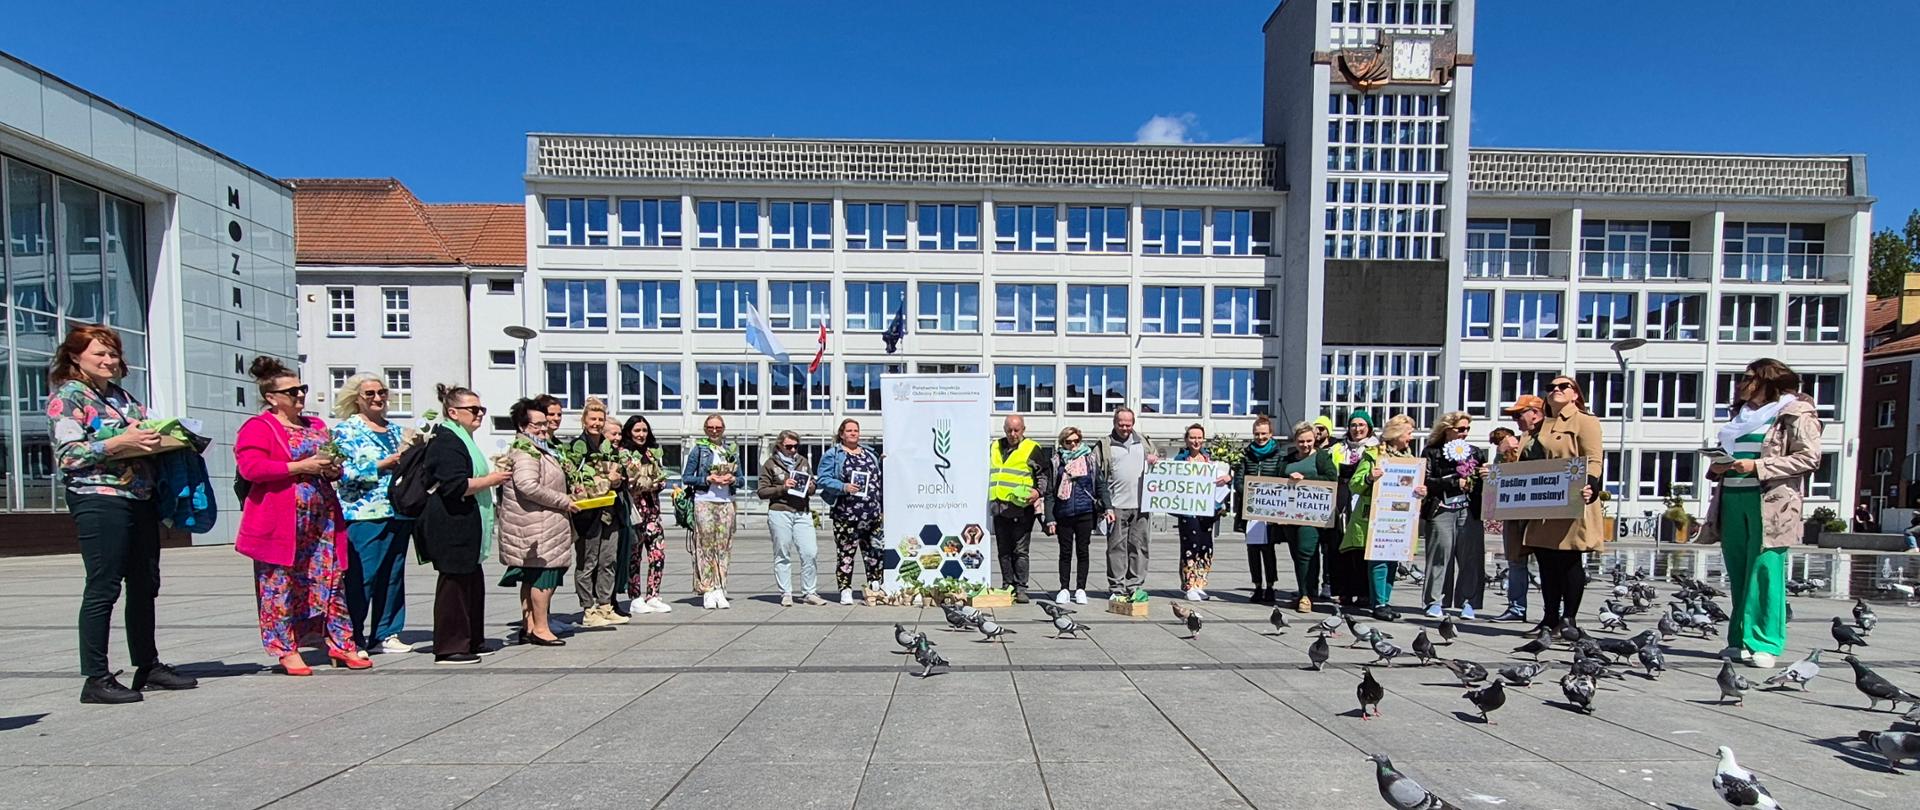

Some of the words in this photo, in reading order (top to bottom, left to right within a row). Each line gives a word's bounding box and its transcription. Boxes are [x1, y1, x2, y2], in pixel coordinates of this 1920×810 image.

[227, 186, 246, 407] MOZAIKA
[917, 483, 954, 494] PIORIN
[1147, 480, 1211, 495] GŁOSEM
[1256, 488, 1282, 497] PLANT
[1297, 491, 1330, 501] PLANET
[1499, 493, 1510, 503] My
[1514, 492, 1526, 502] nie
[1150, 495, 1207, 511] ROŚLIN
[1255, 498, 1287, 507] HEALTH
[1296, 501, 1330, 511] HEALTH
